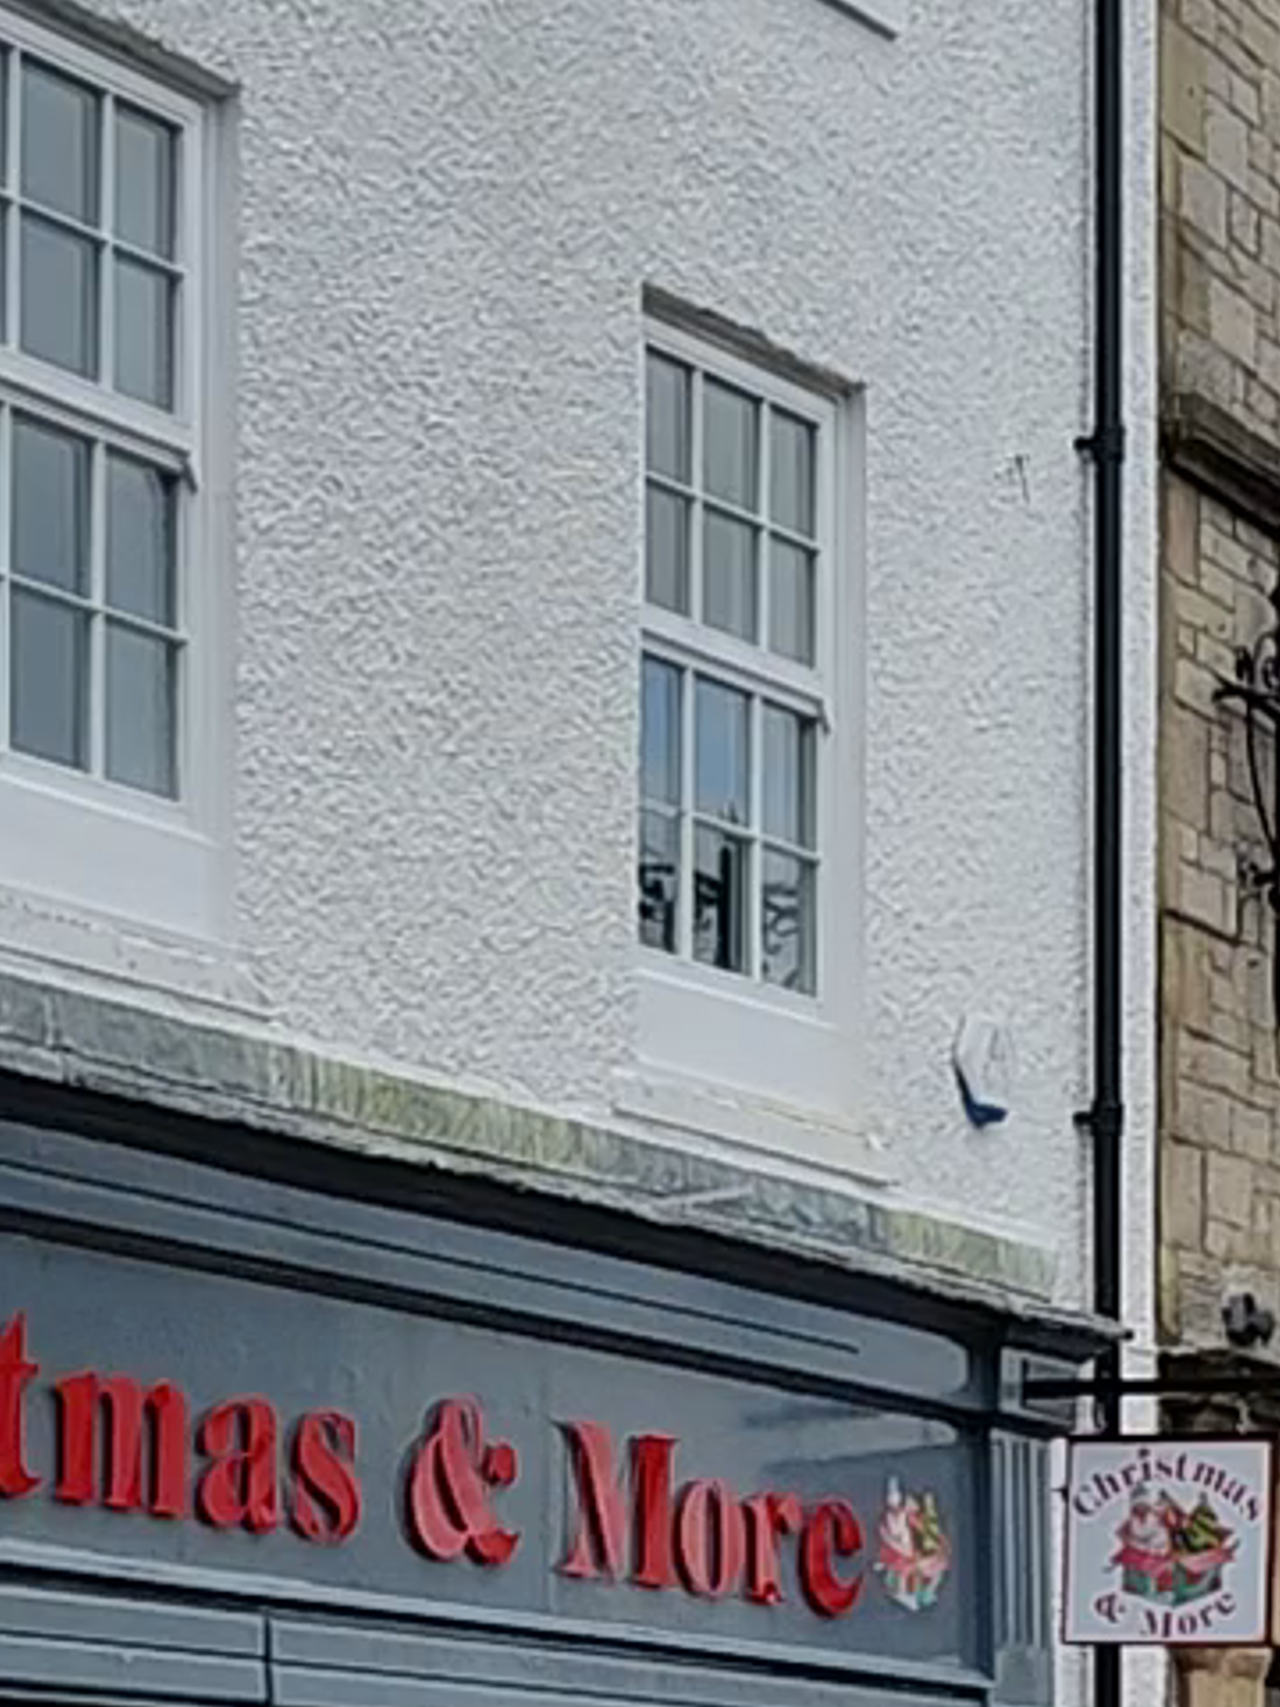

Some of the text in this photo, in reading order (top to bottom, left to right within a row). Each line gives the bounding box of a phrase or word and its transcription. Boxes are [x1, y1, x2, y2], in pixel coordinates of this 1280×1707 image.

[408, 1392, 518, 1567] &
[554, 1417, 865, 1619] More
[1073, 1447, 1260, 1521] Christmas
[1093, 1593, 1237, 1639] & More
